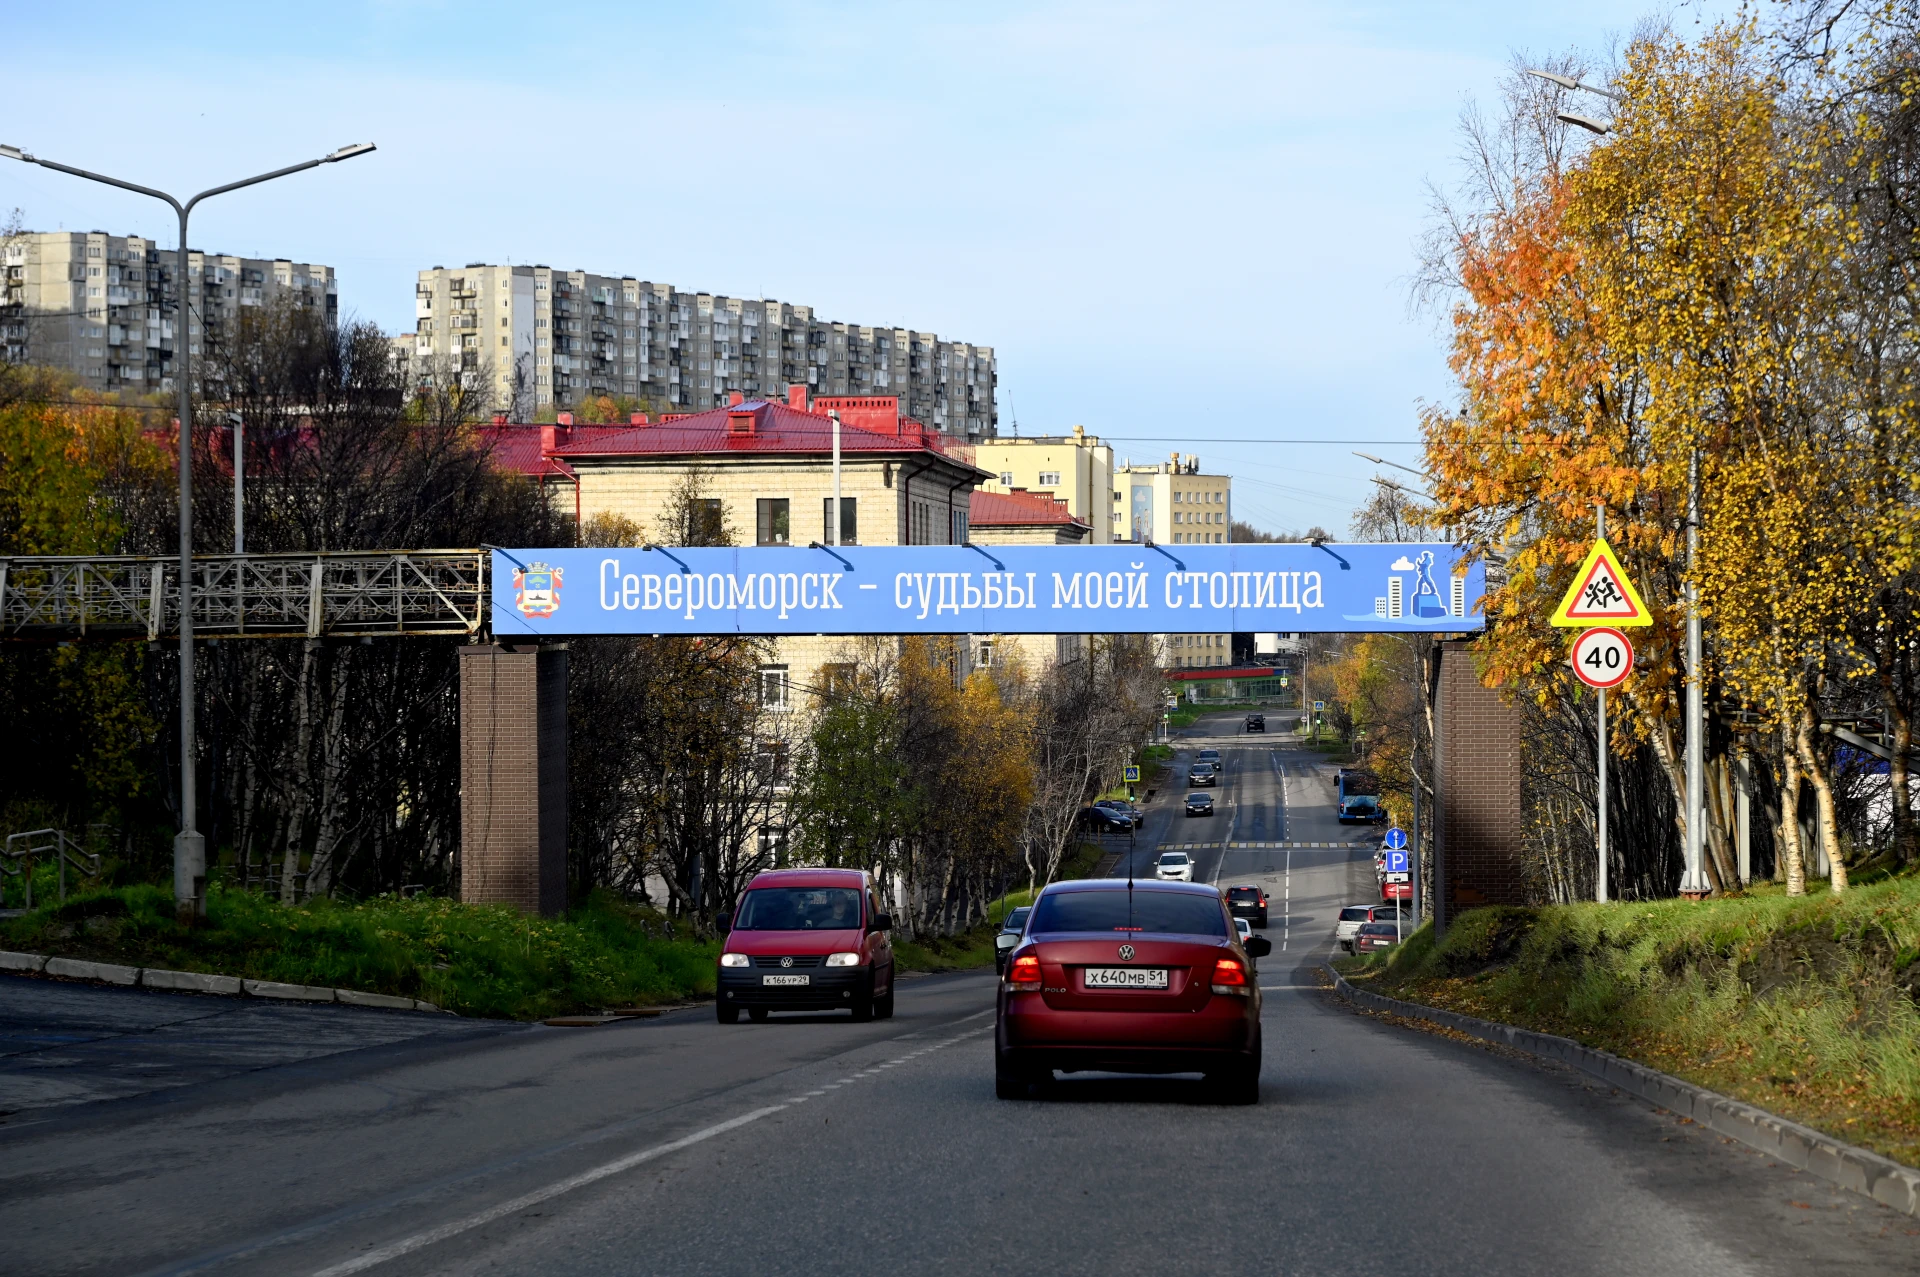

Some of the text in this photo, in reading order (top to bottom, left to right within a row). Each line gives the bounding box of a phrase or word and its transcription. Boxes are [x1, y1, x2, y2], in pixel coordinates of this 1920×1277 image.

[599, 558, 843, 620] Североморск
[894, 571, 1036, 619] судьбы
[1052, 562, 1149, 609] моей
[1165, 569, 1325, 613] столица
[1585, 646, 1620, 668] 40
[1391, 853, 1404, 870] P
